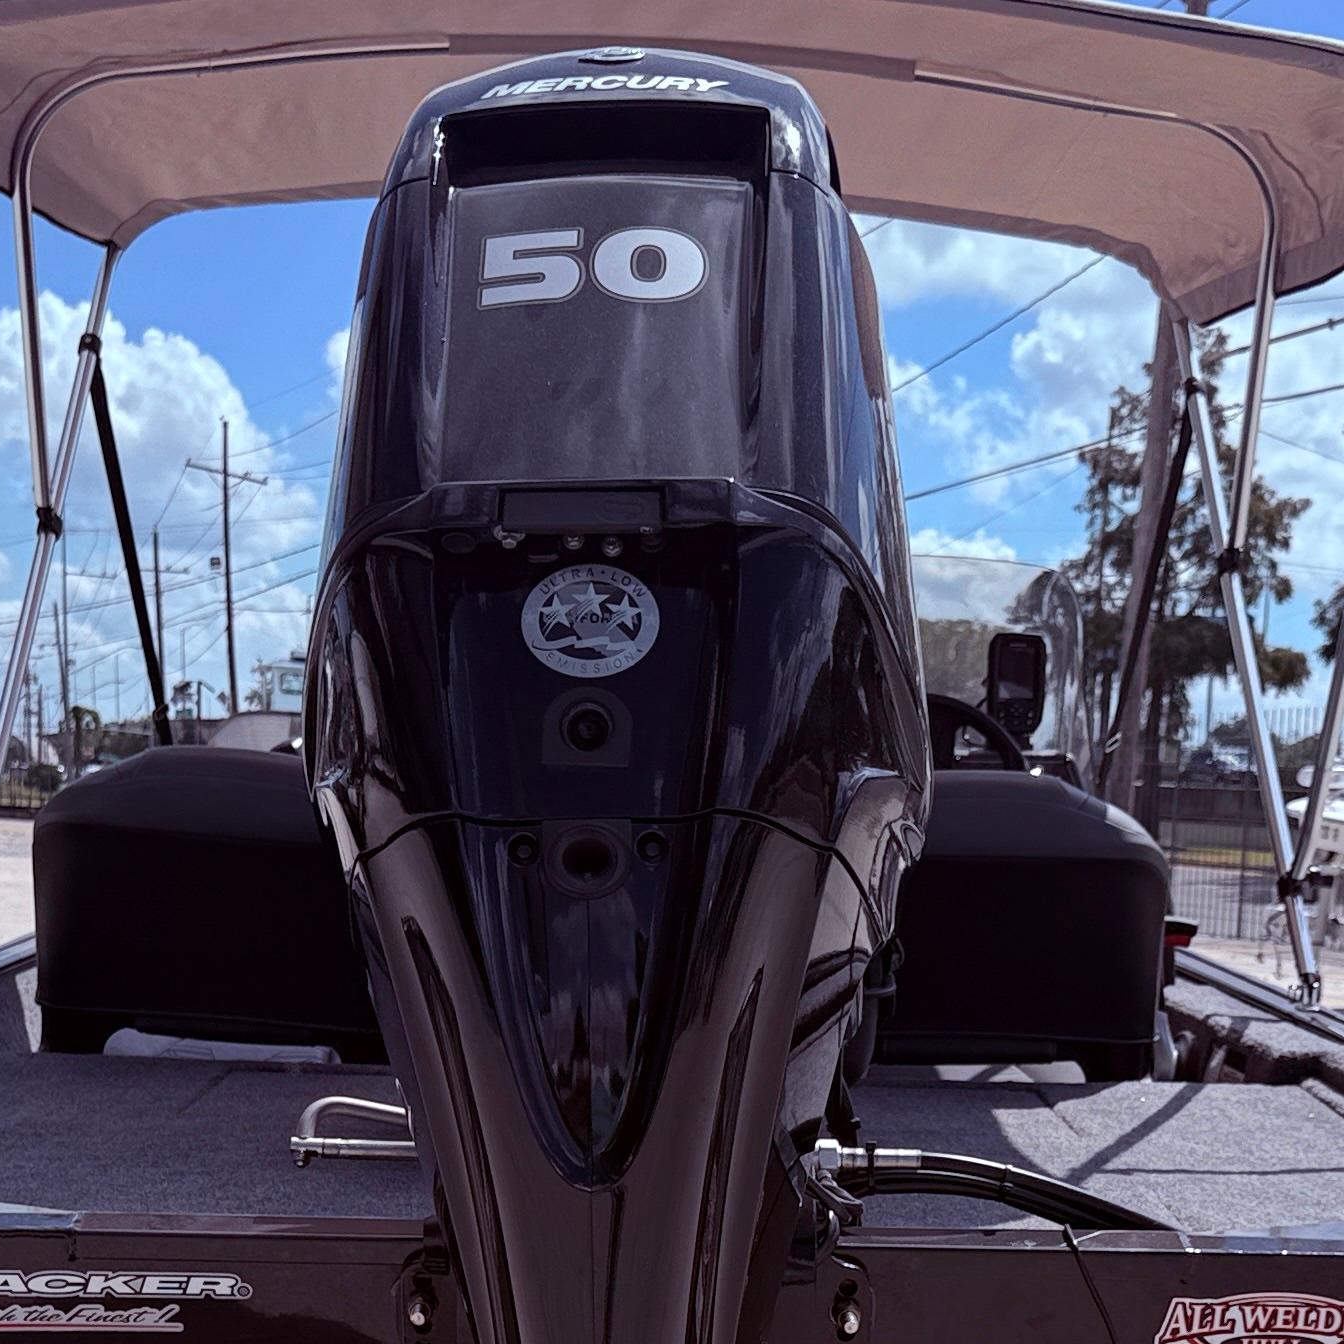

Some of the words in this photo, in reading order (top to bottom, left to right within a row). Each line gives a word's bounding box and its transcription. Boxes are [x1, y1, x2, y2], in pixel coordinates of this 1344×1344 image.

[479, 75, 730, 99] MERCURY
[478, 228, 709, 310] 50
[538, 567, 594, 595] ULTRA
[610, 570, 648, 598] LOW
[23, 1307, 62, 1322] the
[1160, 1301, 1236, 1344] ALL
